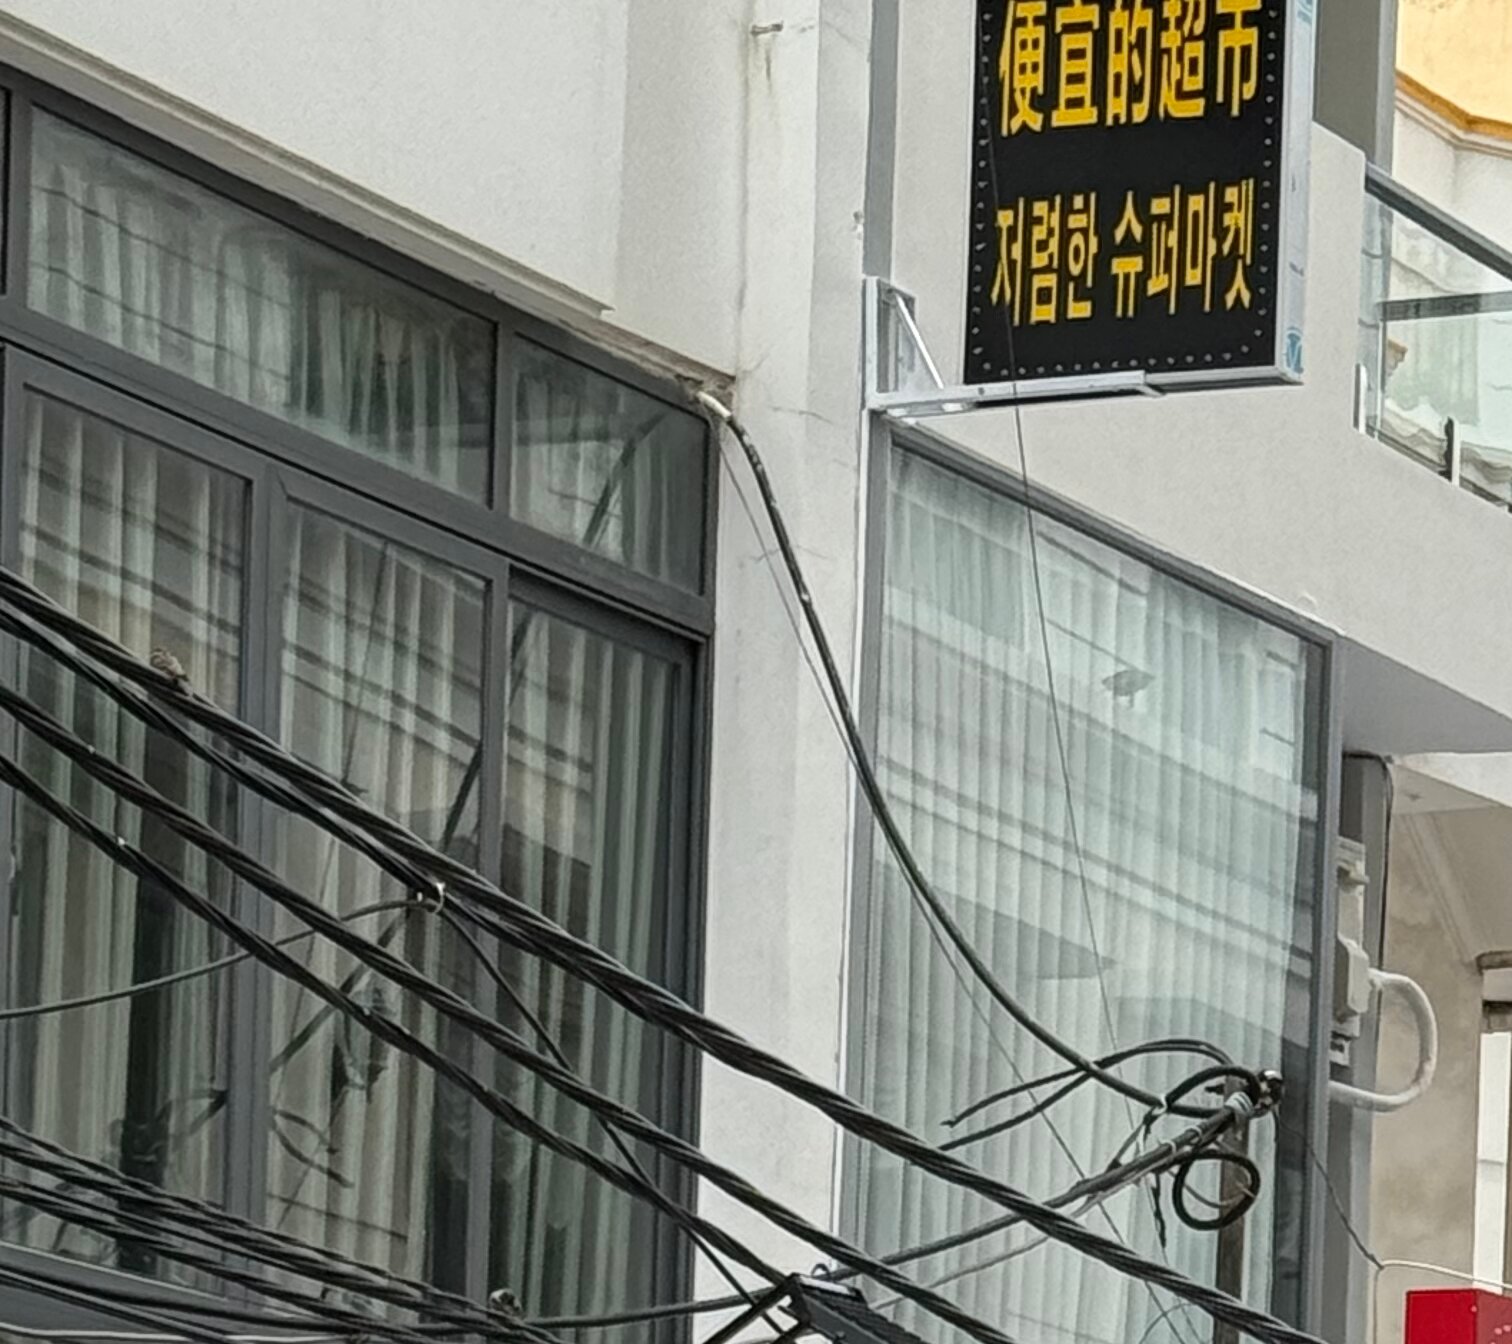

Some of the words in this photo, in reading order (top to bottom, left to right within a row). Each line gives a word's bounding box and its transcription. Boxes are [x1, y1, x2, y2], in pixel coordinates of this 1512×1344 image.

[999, 0, 1262, 137] 便宜的超市
[991, 191, 1098, 326] 저렴한
[1110, 178, 1254, 317] 슈퍼마켓
